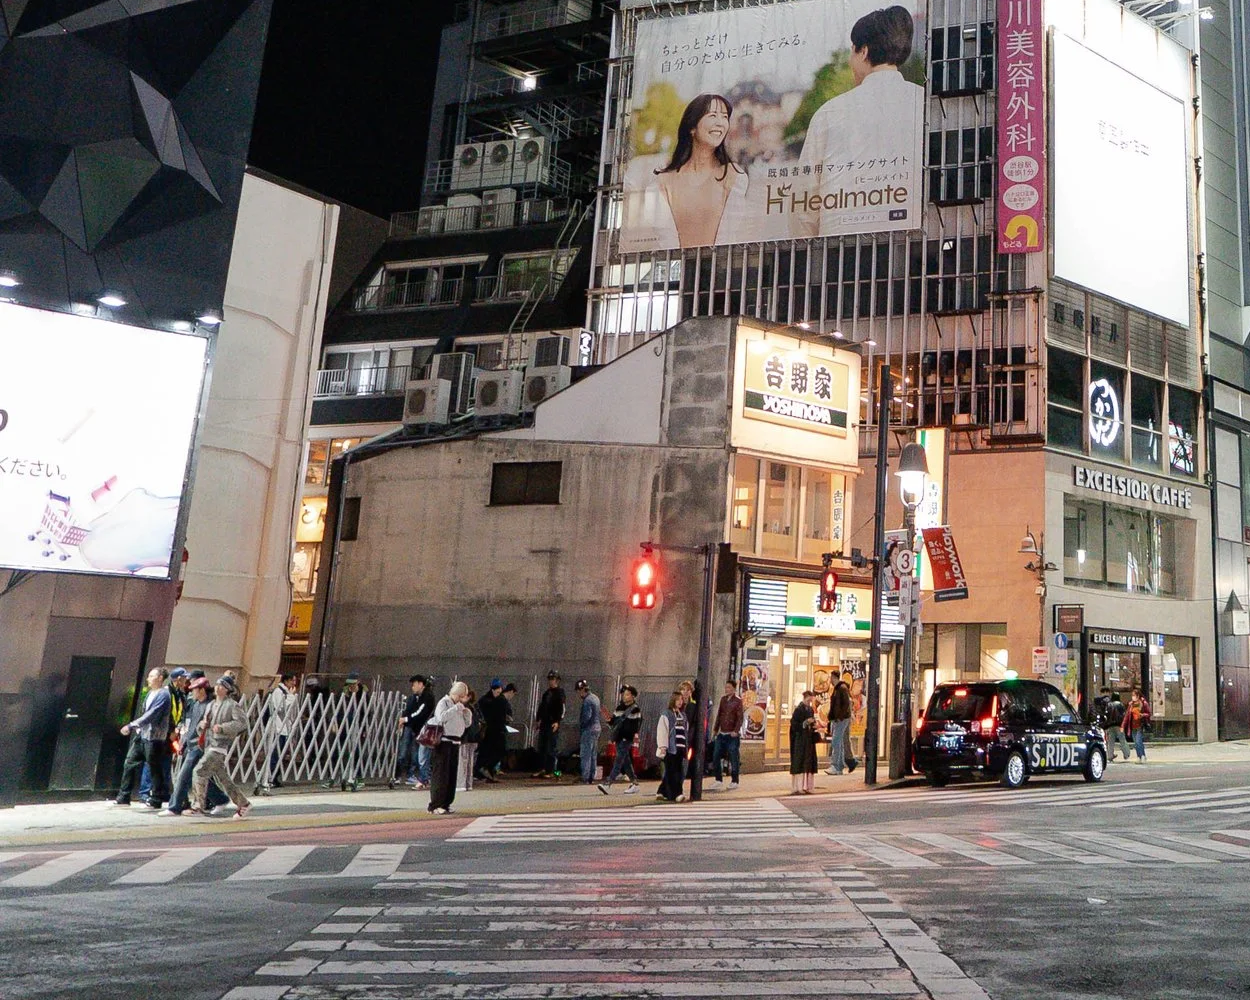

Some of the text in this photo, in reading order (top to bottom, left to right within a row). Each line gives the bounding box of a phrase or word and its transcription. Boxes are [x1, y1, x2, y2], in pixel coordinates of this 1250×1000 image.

[661, 34, 807, 74] 自分のために生きてみる。
[662, 33, 728, 56] ちょっとだけ
[767, 155, 909, 178] 既婚者専用マッチングサイト
[791, 184, 908, 213] Healmate
[766, 355, 832, 399] 吉野家
[763, 395, 832, 424] YOSHINOYA
[1075, 466, 1150, 501] EXCELSIOR
[901, 553, 909, 569] 3
[1093, 633, 1127, 645] EXCELSIOR
[1031, 743, 1079, 768] S.RIDE
